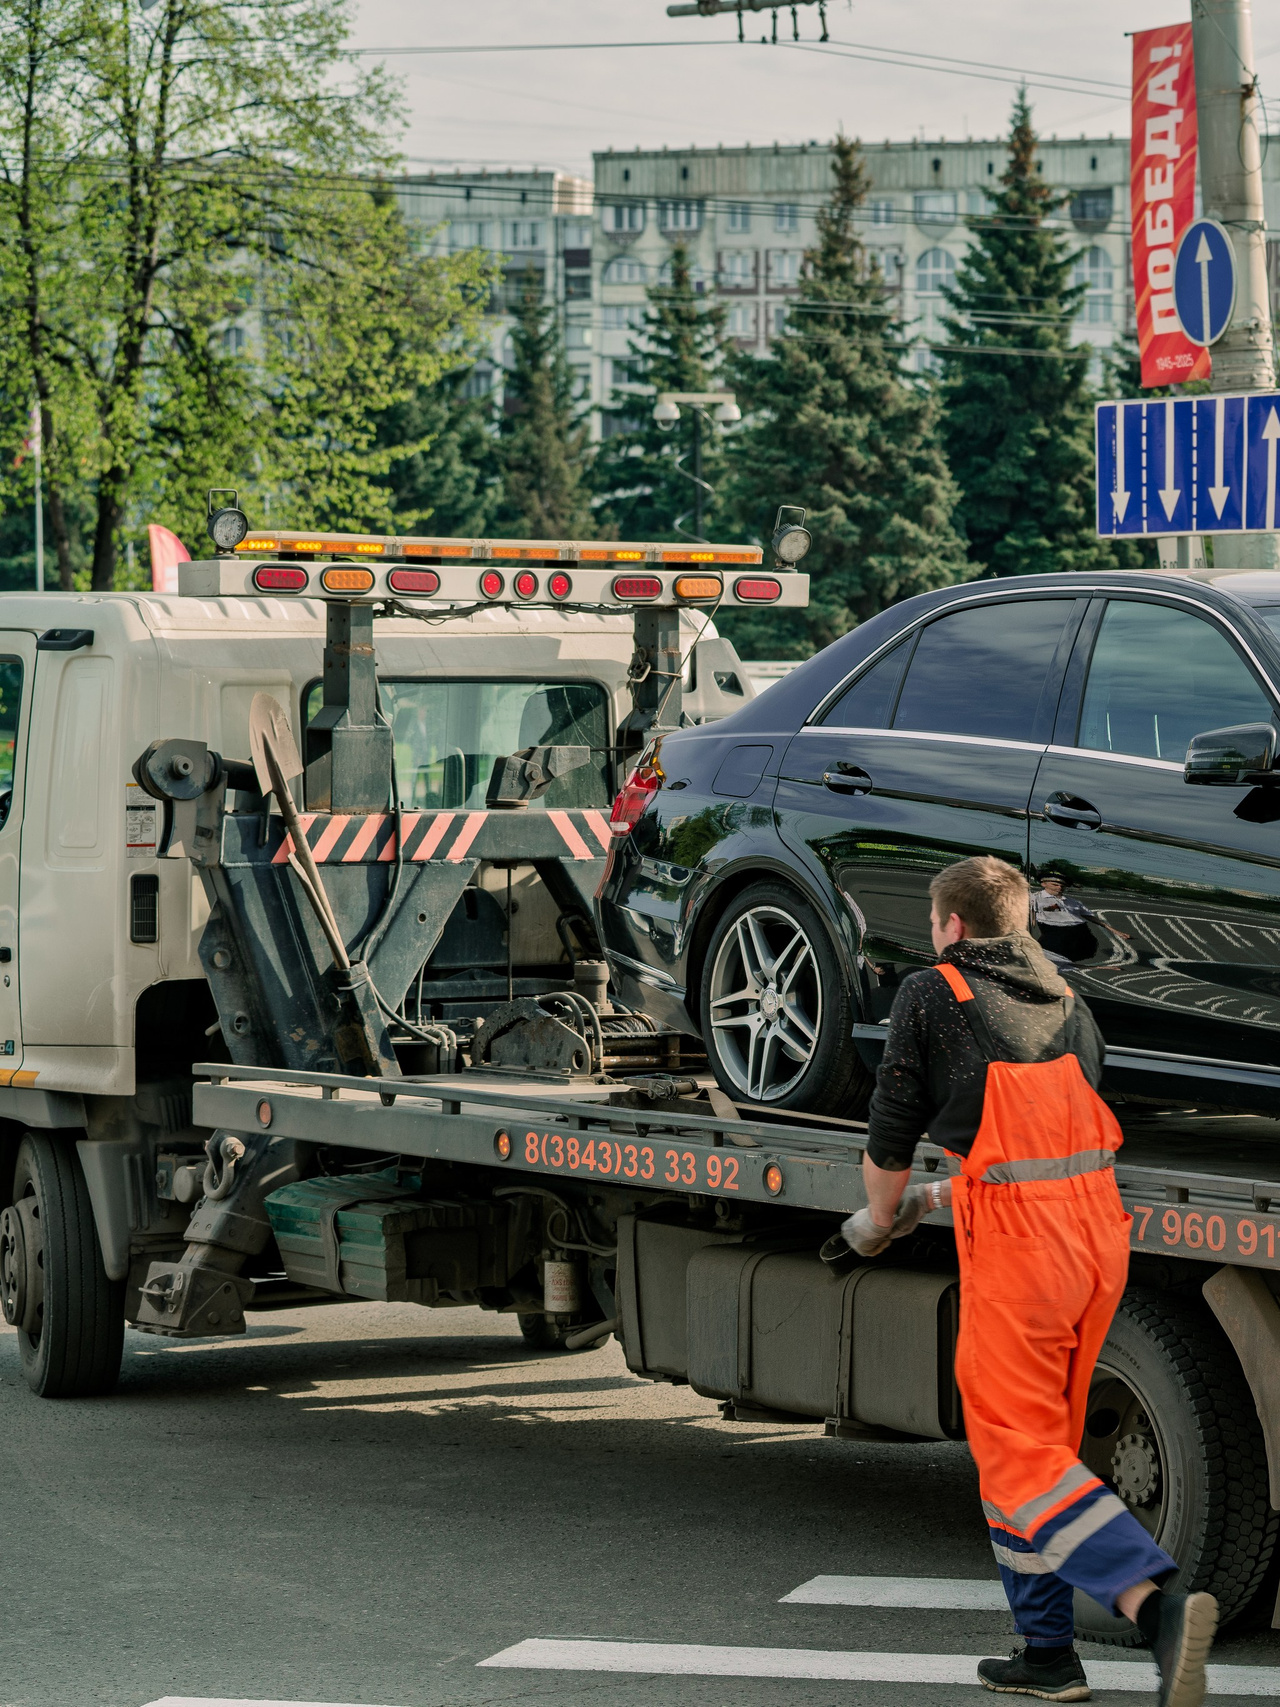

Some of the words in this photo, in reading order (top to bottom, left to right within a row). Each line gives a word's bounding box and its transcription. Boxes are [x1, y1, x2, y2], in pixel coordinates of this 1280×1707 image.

[1145, 43, 1184, 336] ПОБЕДА!
[525, 1132, 655, 1179] 8(3843)33
[665, 1150, 697, 1185] 33
[706, 1155, 739, 1190] 92
[1162, 1209, 1227, 1251] 960
